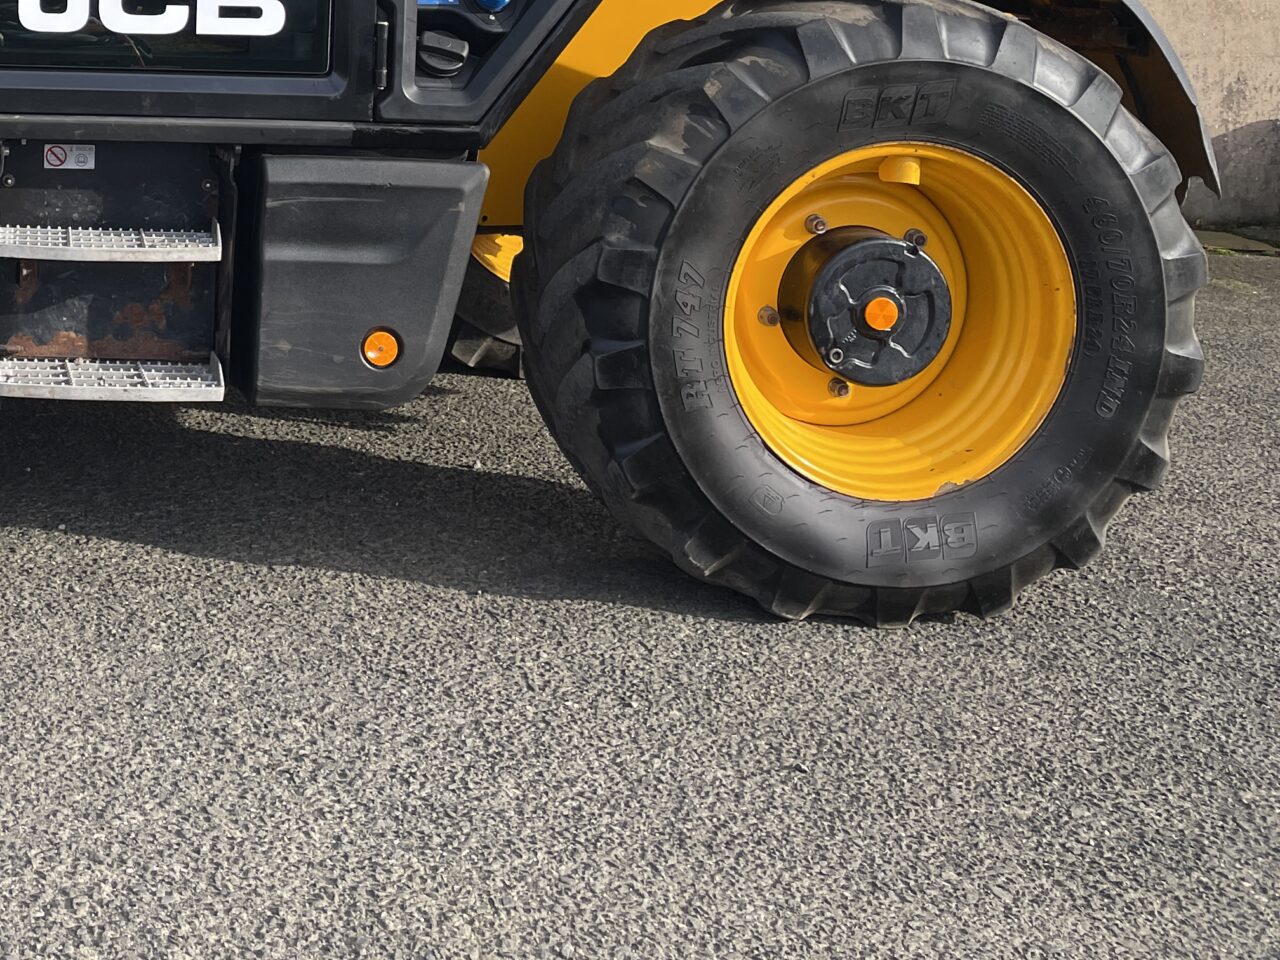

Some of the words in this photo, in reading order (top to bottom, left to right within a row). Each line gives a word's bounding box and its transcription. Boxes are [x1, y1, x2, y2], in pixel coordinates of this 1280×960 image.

[841, 89, 952, 126] BKT
[671, 259, 706, 338] 747
[870, 521, 976, 557] BKT
